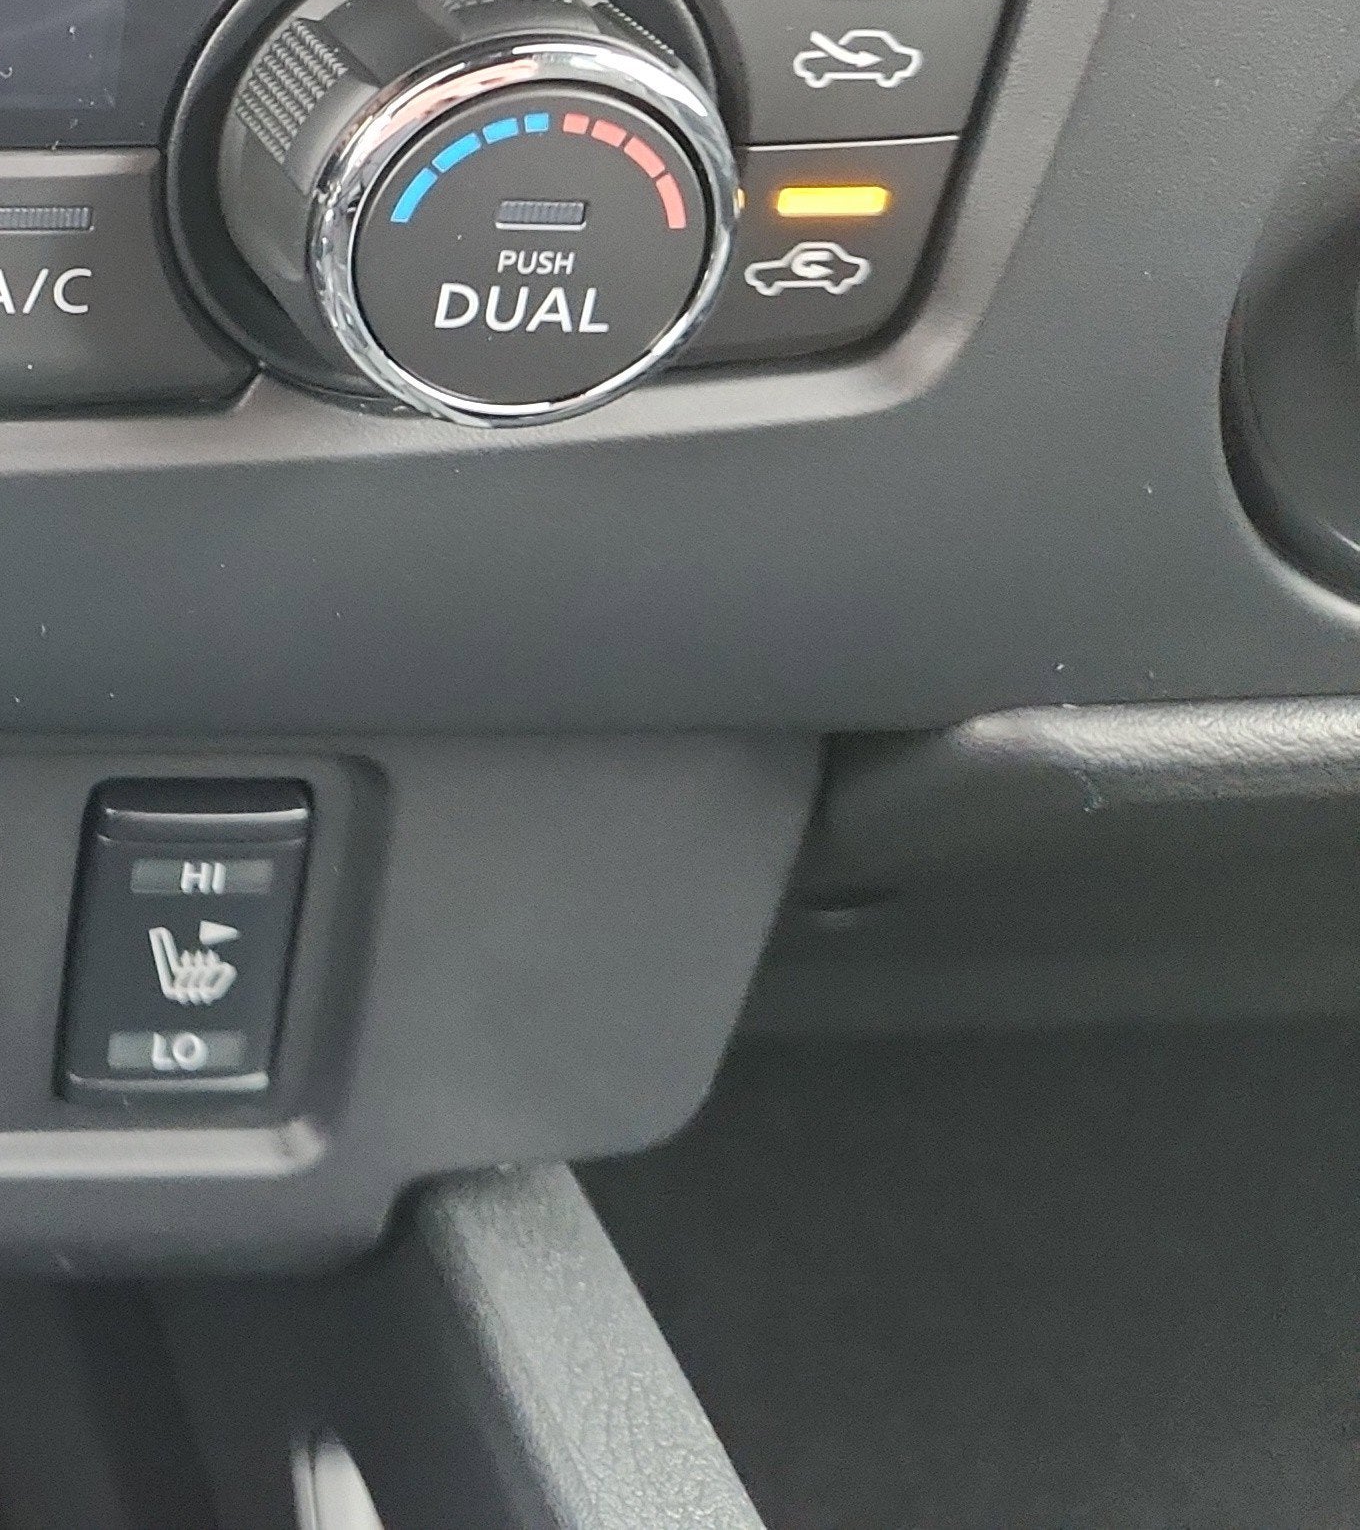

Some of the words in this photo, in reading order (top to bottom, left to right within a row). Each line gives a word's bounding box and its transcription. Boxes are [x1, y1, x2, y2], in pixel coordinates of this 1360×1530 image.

[497, 248, 576, 276] PUSH
[433, 282, 610, 334] DUAL
[179, 861, 226, 894] HI
[150, 1032, 209, 1071] LO
